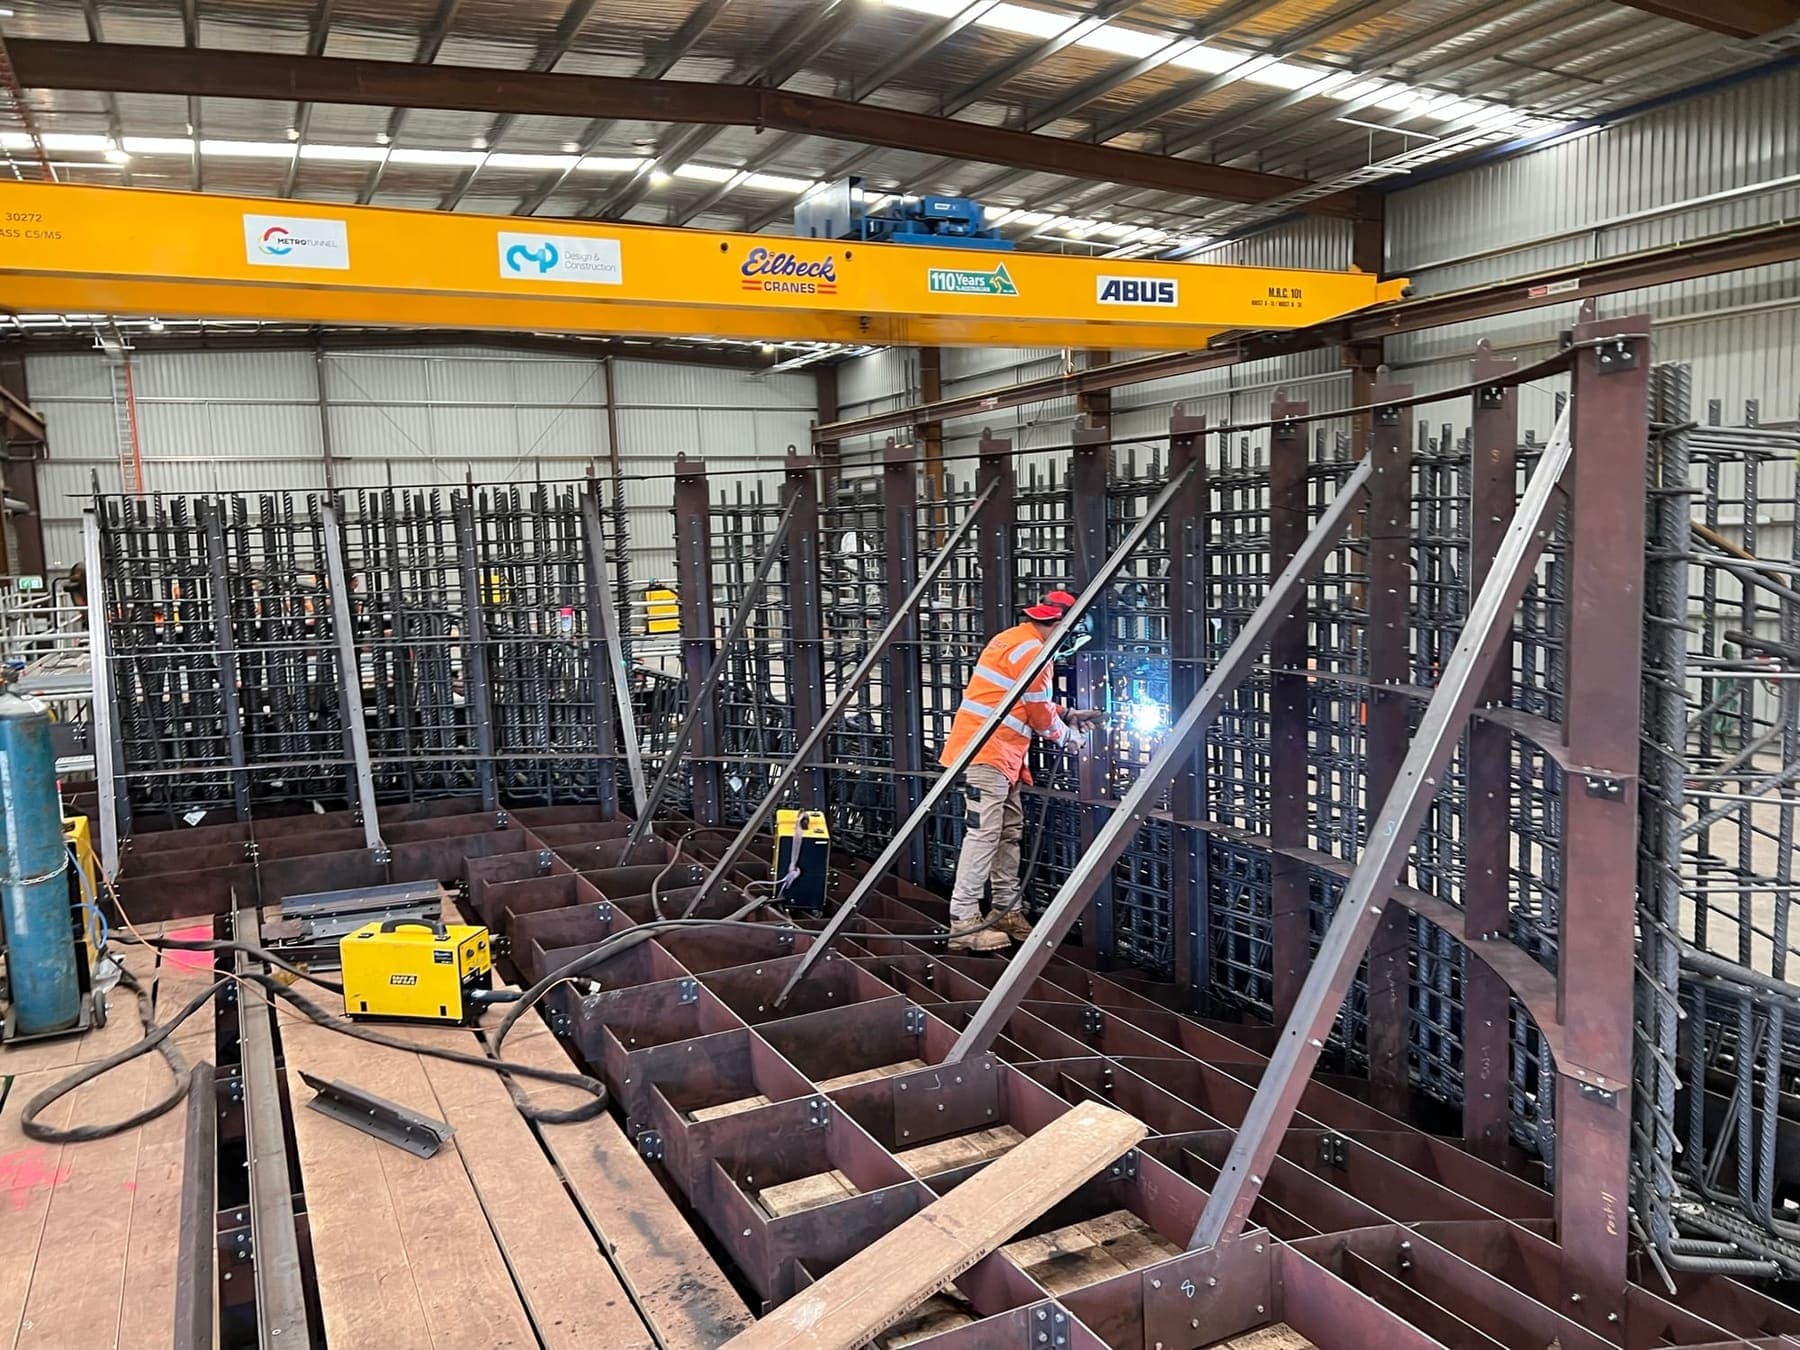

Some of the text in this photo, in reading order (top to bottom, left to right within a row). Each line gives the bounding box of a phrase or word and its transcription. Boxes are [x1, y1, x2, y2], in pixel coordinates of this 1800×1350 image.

[5, 212, 42, 222] 30272
[565, 251, 592, 262] Design
[565, 261, 616, 272] Construction
[741, 247, 836, 282] Eilbeck
[764, 281, 816, 293] CRANES
[931, 272, 985, 291] 110 Years
[1100, 280, 1174, 303] ABUS
[391, 975, 416, 985] WIA
[1181, 1280, 1195, 1298] 8
